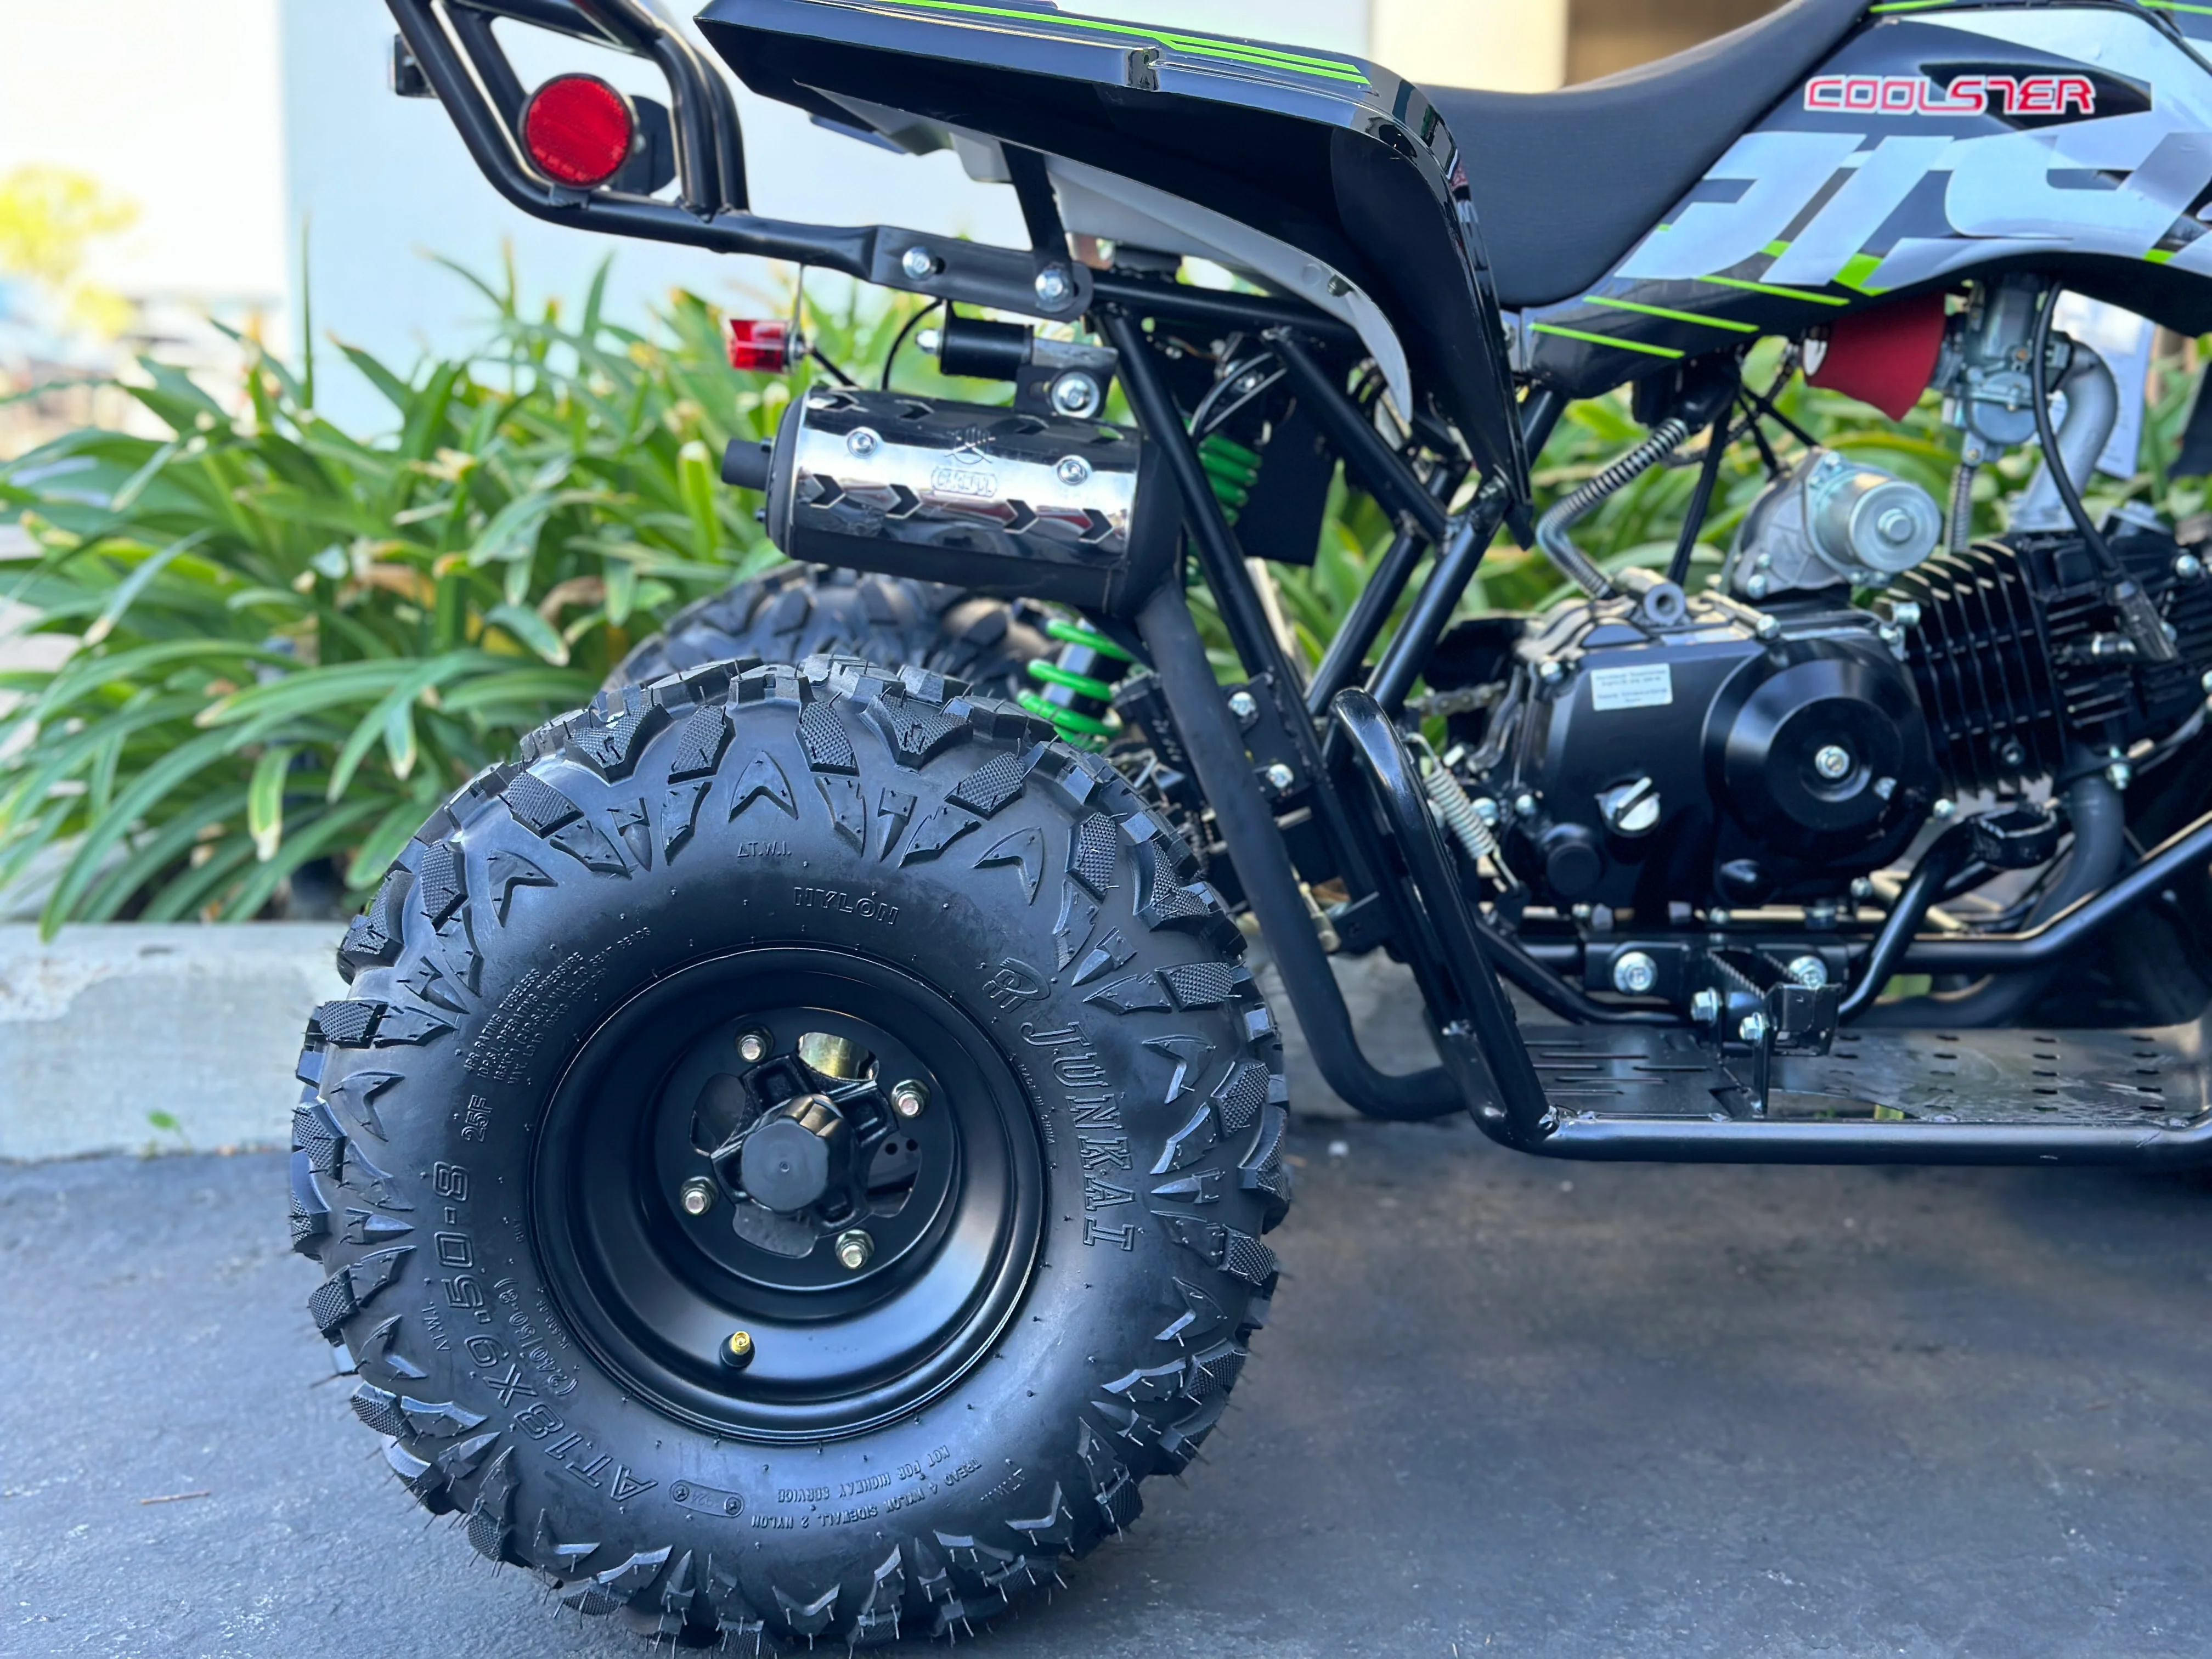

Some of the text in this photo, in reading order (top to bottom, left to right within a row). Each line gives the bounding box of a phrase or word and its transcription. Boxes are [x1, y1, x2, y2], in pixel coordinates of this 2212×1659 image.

[1804, 75, 2095, 115] COOLSTER
[795, 887, 900, 925] NYLON
[572, 966, 588, 979] TO
[588, 945, 613, 967] SEAT
[616, 926, 652, 950] BEADS
[464, 968, 540, 1071] 4PR RATING TUBELESS
[496, 992, 539, 1044] OPERATING
[537, 951, 584, 991] PRESSURE
[522, 1031, 545, 1058] LOAD
[461, 1094, 493, 1142] 25F
[1018, 1063, 1056, 1146] MADE IN CHINA
[1020, 1022, 1137, 1251] JUNKAI
[493, 1276, 579, 1398] (240/50-8)
[750, 1456, 982, 1530] TREAD 4 NYLON SIDEWALL 2 NYLON
[777, 1445, 950, 1503] NOT FOR HIGHWAY SERVICE
